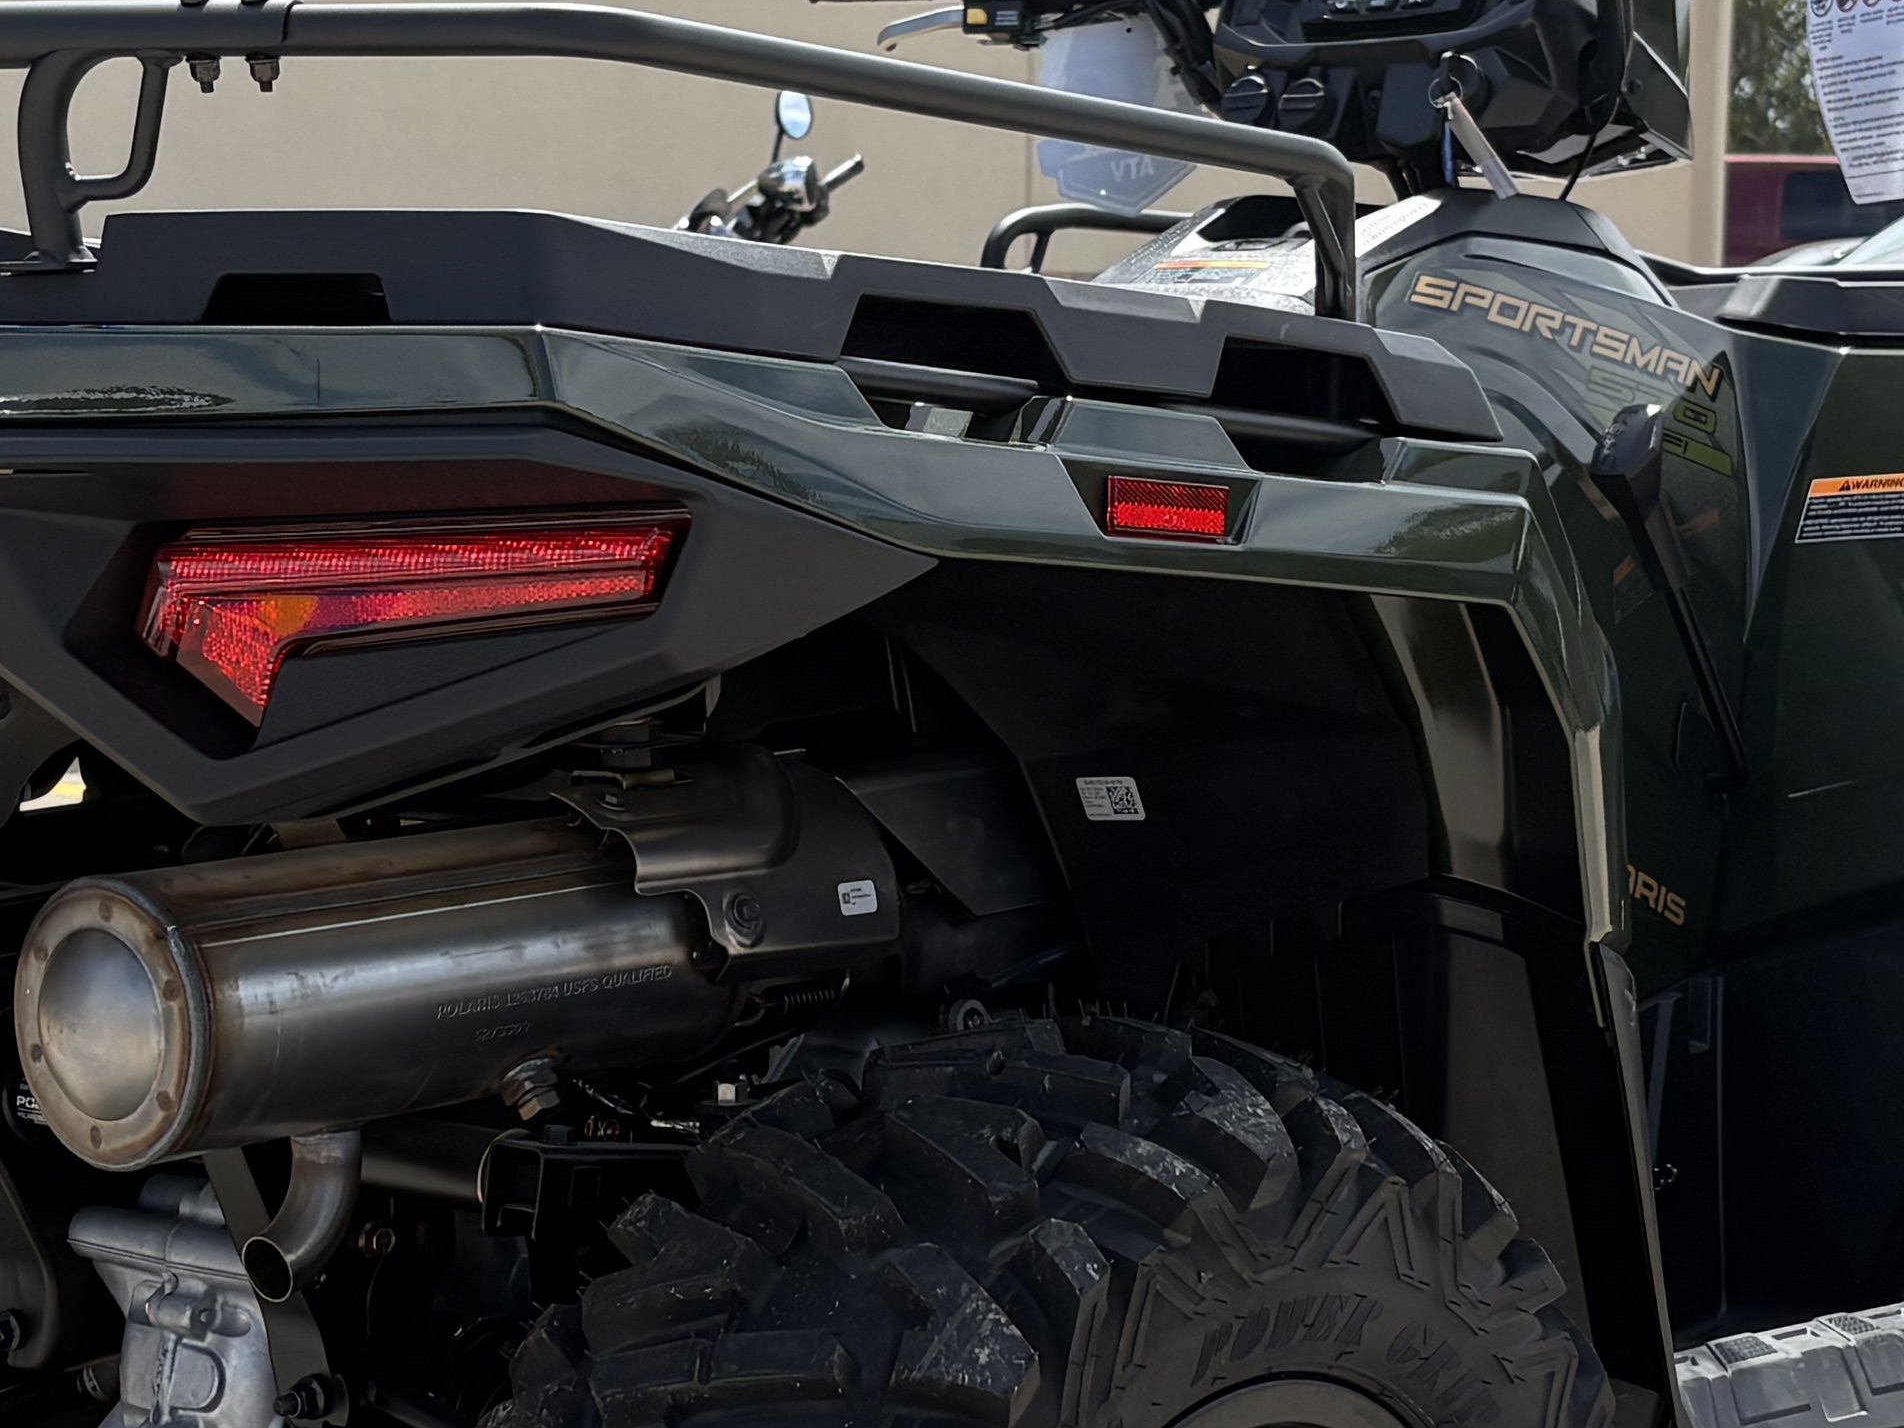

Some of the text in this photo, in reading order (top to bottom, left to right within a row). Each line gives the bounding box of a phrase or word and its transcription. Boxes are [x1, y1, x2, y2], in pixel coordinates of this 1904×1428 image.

[1409, 274, 1722, 398] SPORTSMAN
[436, 994, 502, 1020] POLARIS
[562, 978, 600, 997] USFS
[601, 964, 674, 990] QUALIFIED
